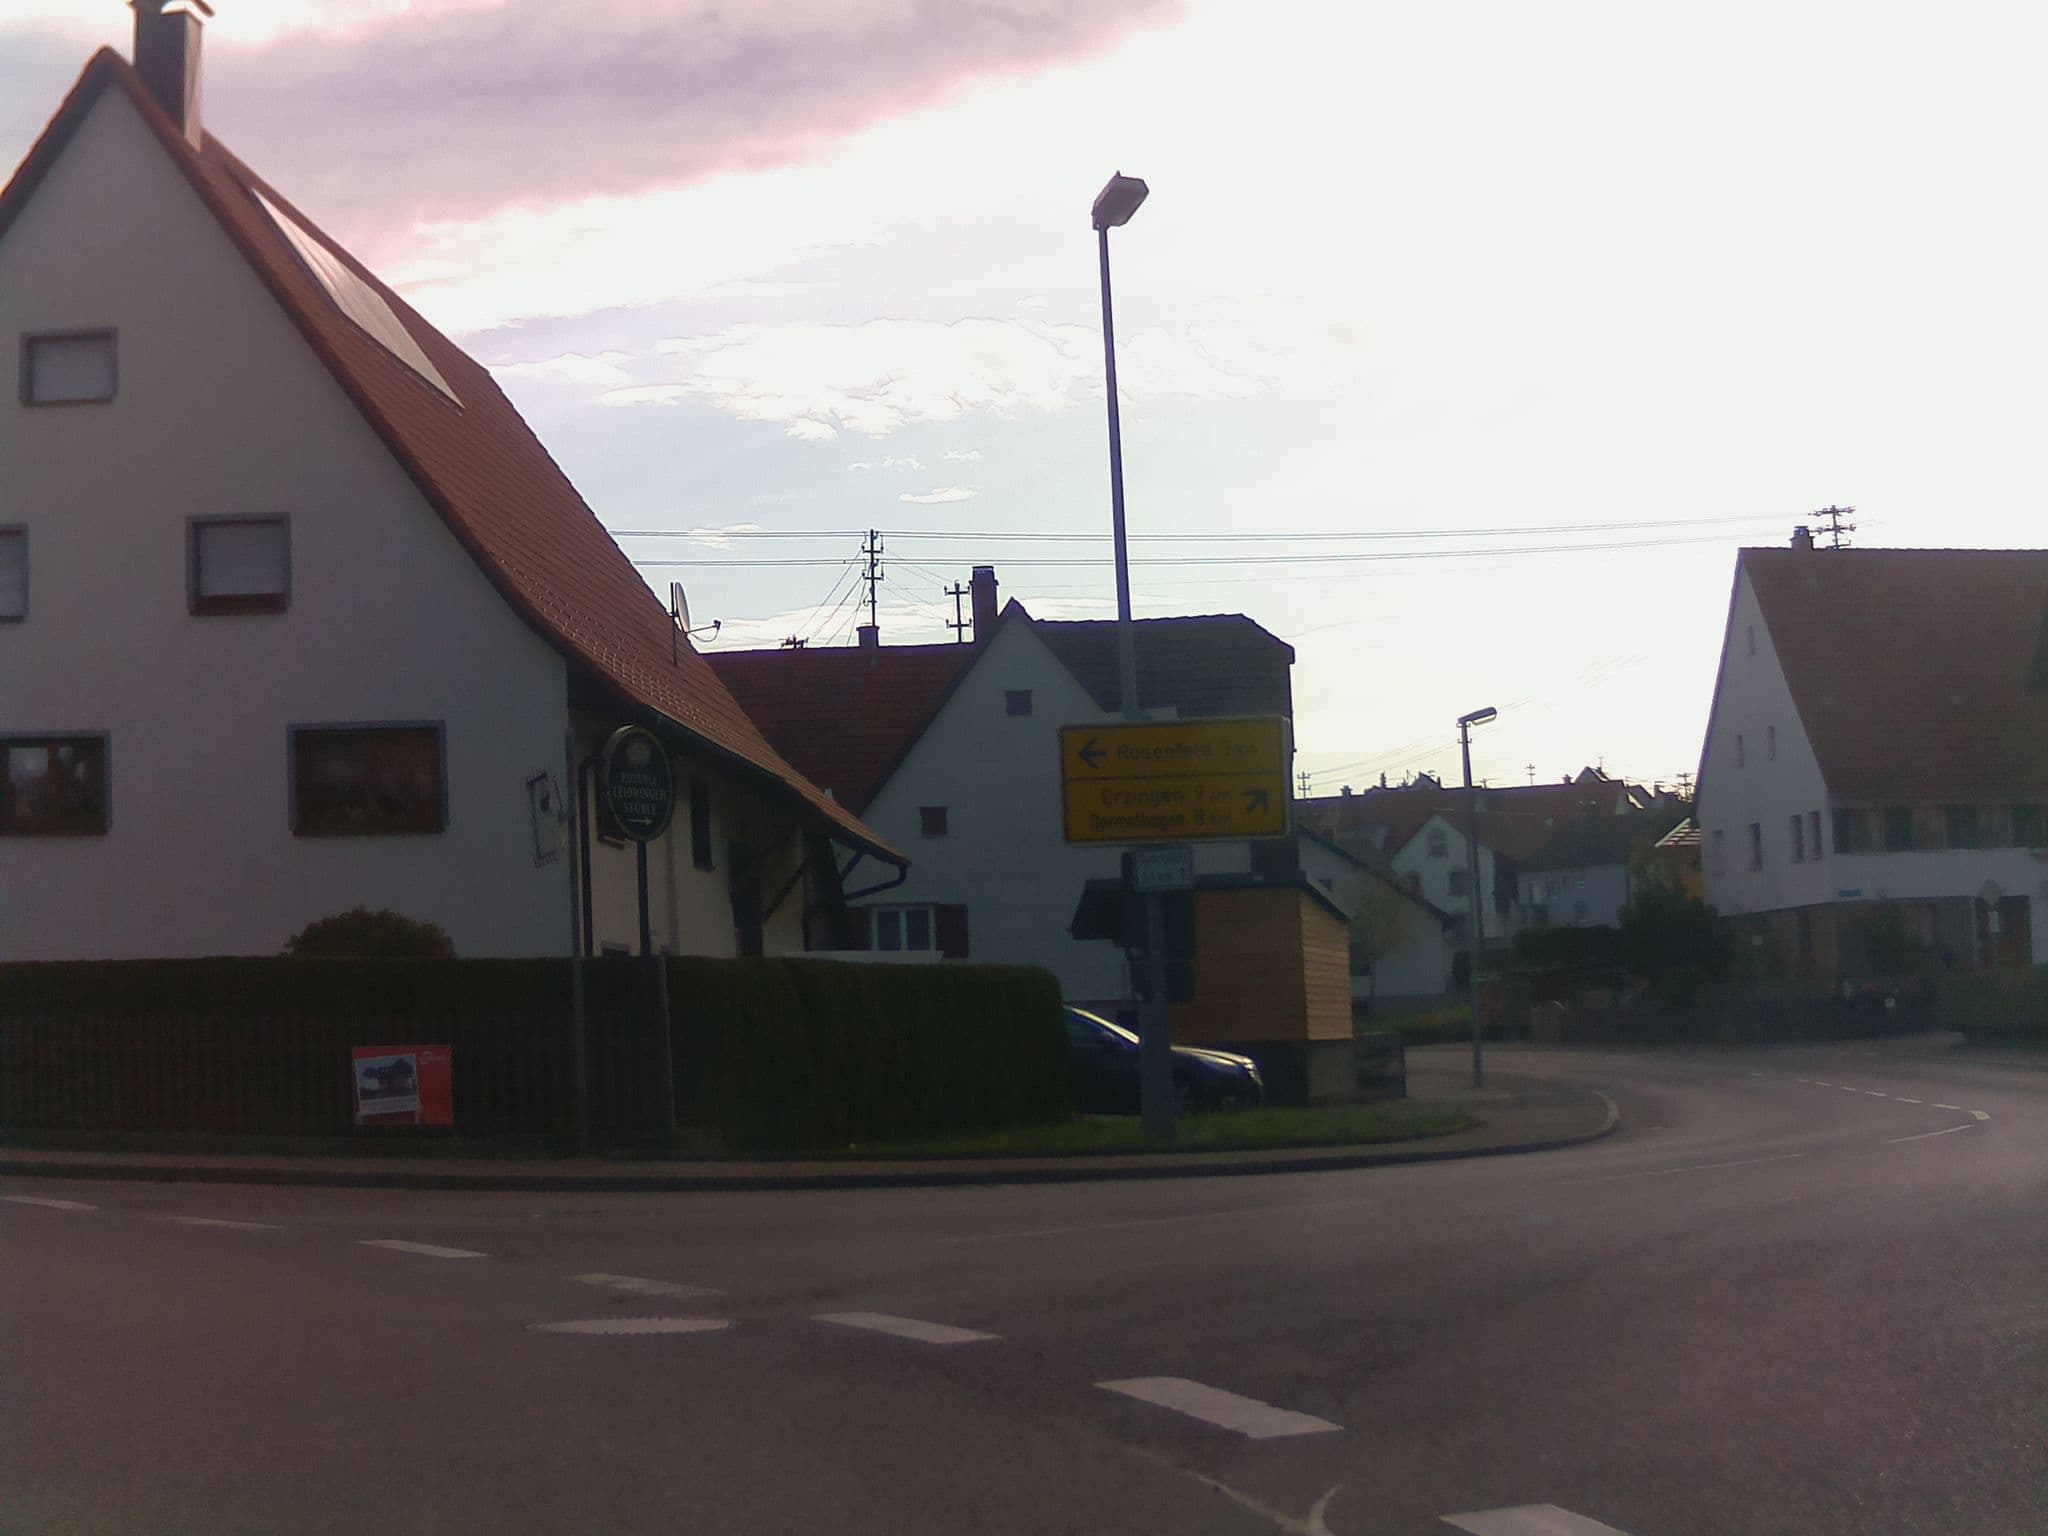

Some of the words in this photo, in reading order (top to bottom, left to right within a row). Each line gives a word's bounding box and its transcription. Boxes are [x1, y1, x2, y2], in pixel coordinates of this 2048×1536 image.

[1117, 742, 1212, 760] Rosenfeld
[613, 786, 666, 800] LEIDRINGER
[1102, 787, 1185, 807] Erzingen
